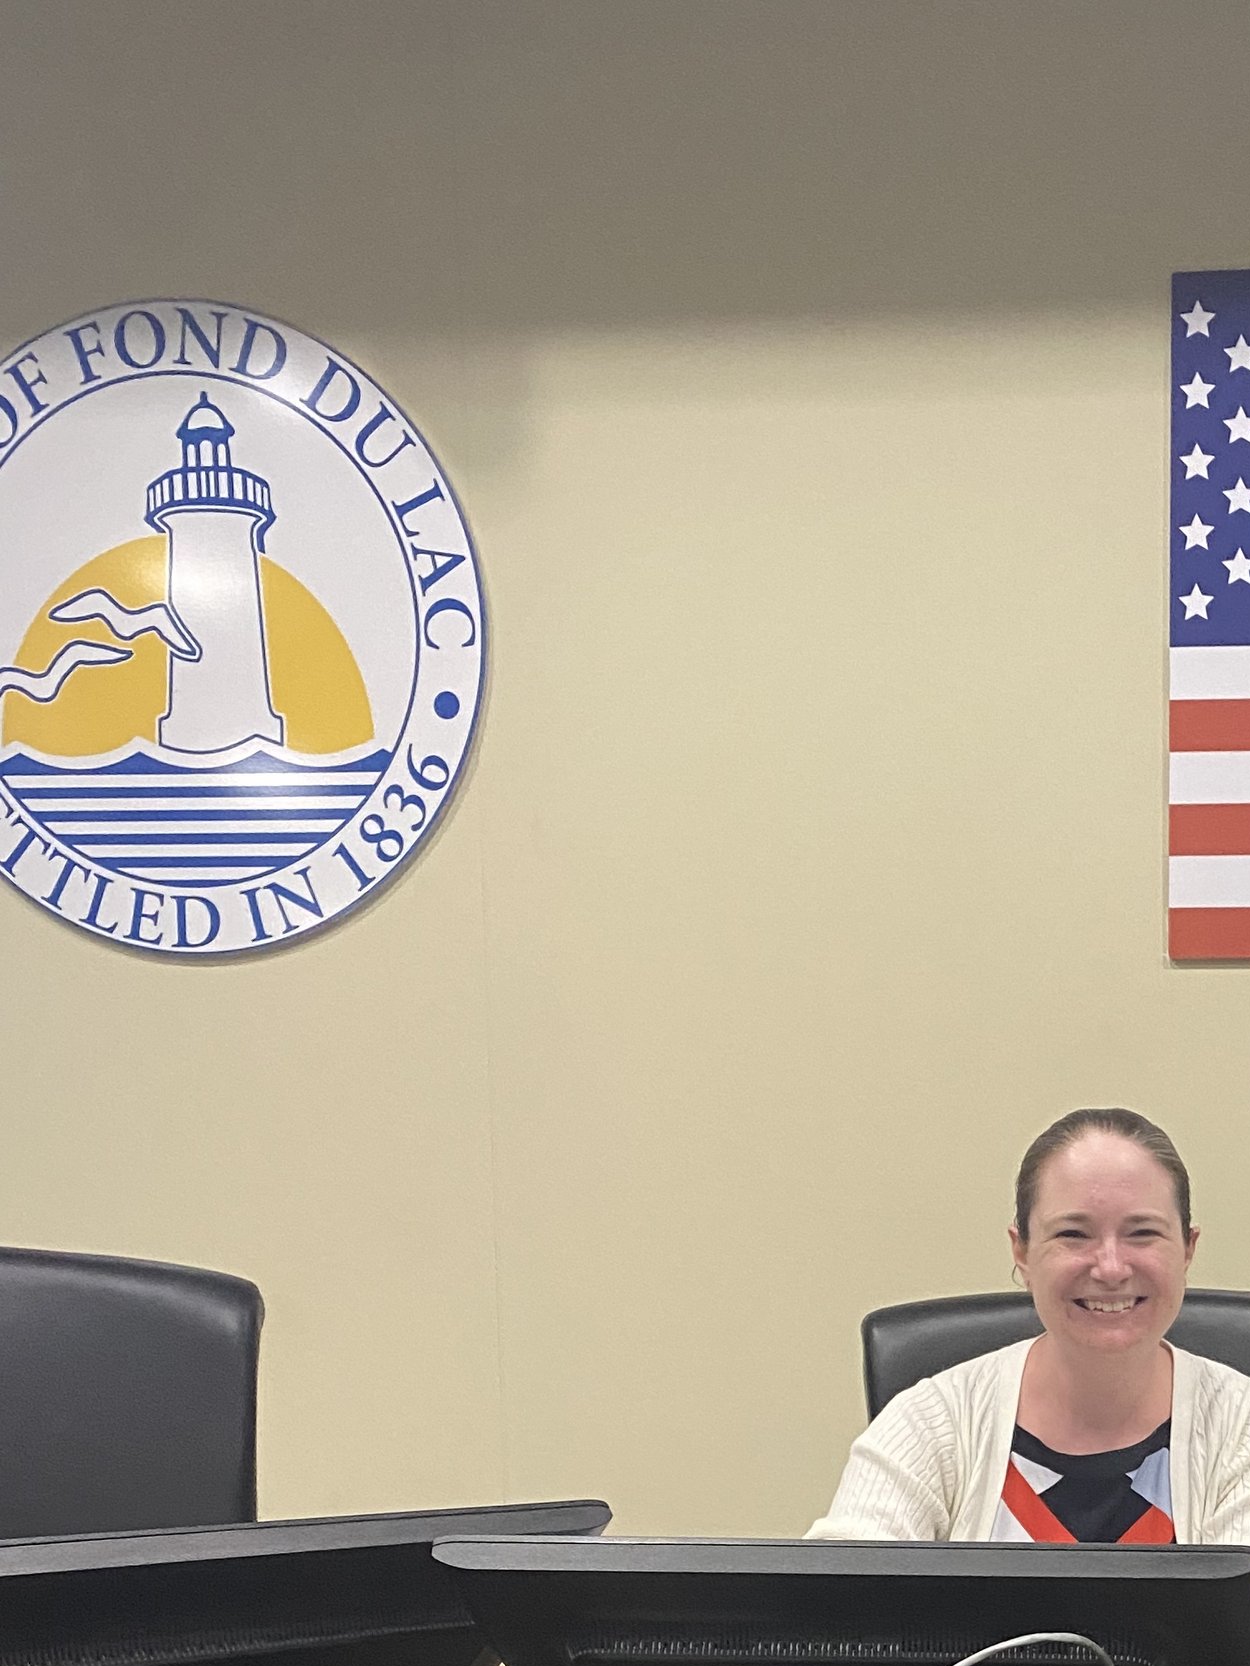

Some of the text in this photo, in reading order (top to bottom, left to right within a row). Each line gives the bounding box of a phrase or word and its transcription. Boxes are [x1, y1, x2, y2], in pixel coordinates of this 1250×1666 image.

[62, 306, 286, 385] FOND
[300, 356, 416, 467] DU
[392, 479, 475, 649] LAC
[0, 744, 449, 947] TTLED IN 1836
